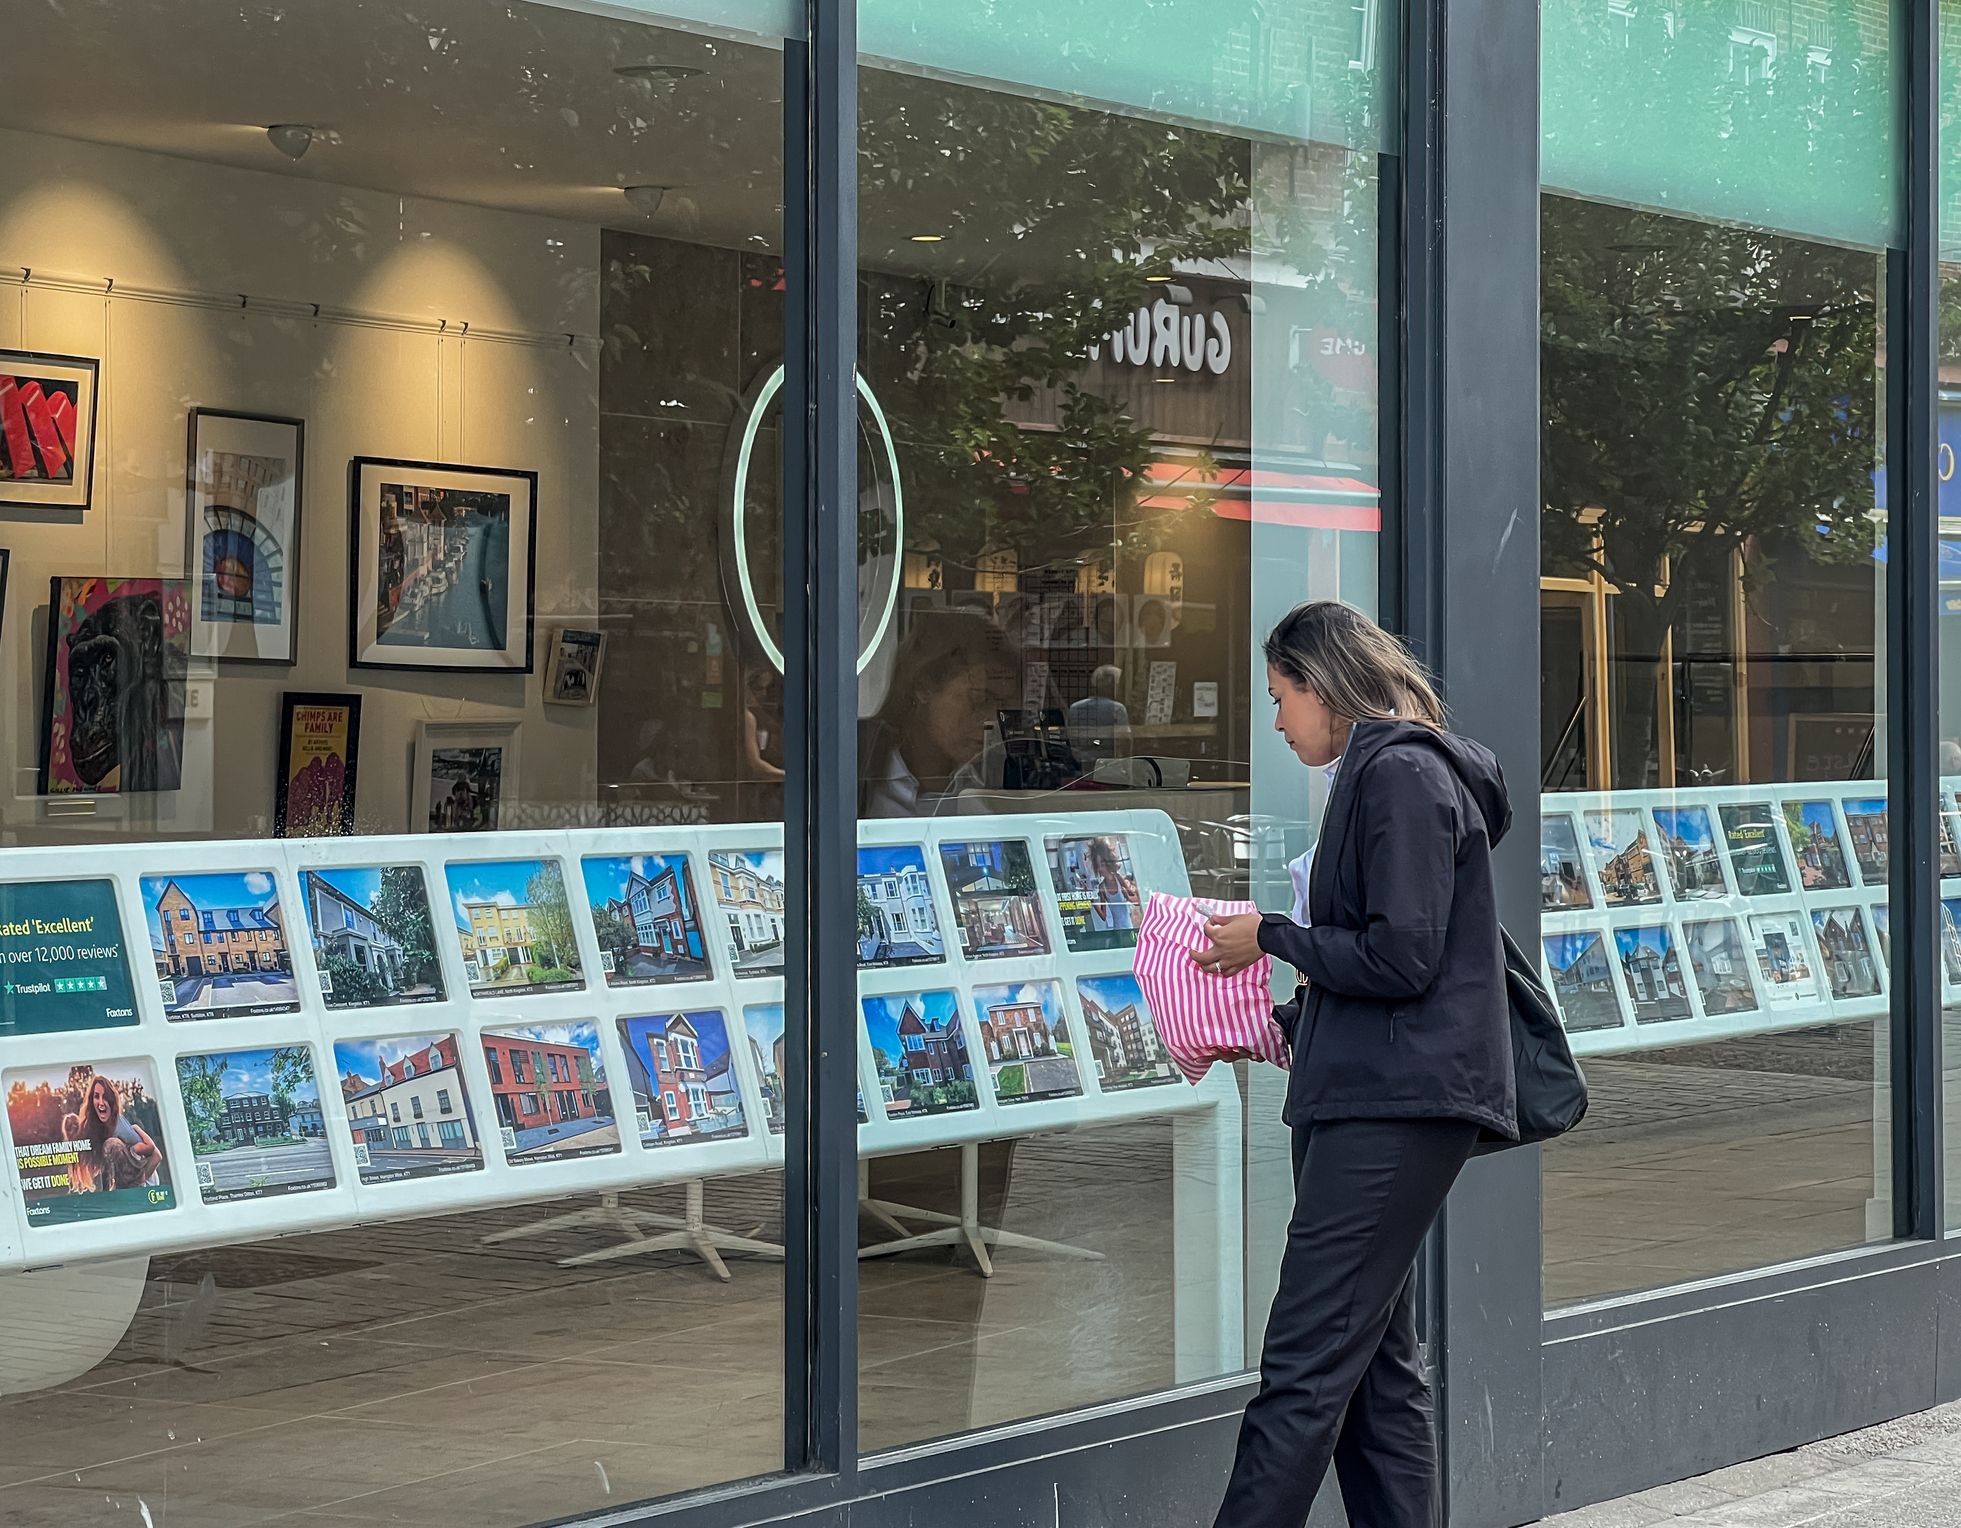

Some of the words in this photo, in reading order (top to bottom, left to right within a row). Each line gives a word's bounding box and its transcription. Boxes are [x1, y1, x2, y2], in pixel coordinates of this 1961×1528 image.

[296, 711, 326, 721] CHIMPS
[327, 711, 343, 722] ARE
[304, 722, 334, 733] FAMILY
[32, 917, 94, 934] 'Excellent'
[9, 951, 32, 963] over
[35, 945, 75, 963] 12,000
[15, 983, 51, 995] Trustpilot
[106, 1007, 133, 1018] Foxtons
[15, 1145, 30, 1158] THAT
[30, 1143, 52, 1156] DREAM
[52, 1140, 73, 1154] FAMILY
[73, 1139, 92, 1151] HOME
[24, 1155, 52, 1169] POSSIBLE
[52, 1152, 79, 1165] MOMENT
[20, 1178, 33, 1191] WE
[32, 1176, 45, 1189] GET
[44, 1175, 51, 1188] IT
[50, 1173, 70, 1187] DONE
[26, 1205, 50, 1216] Foxtons
